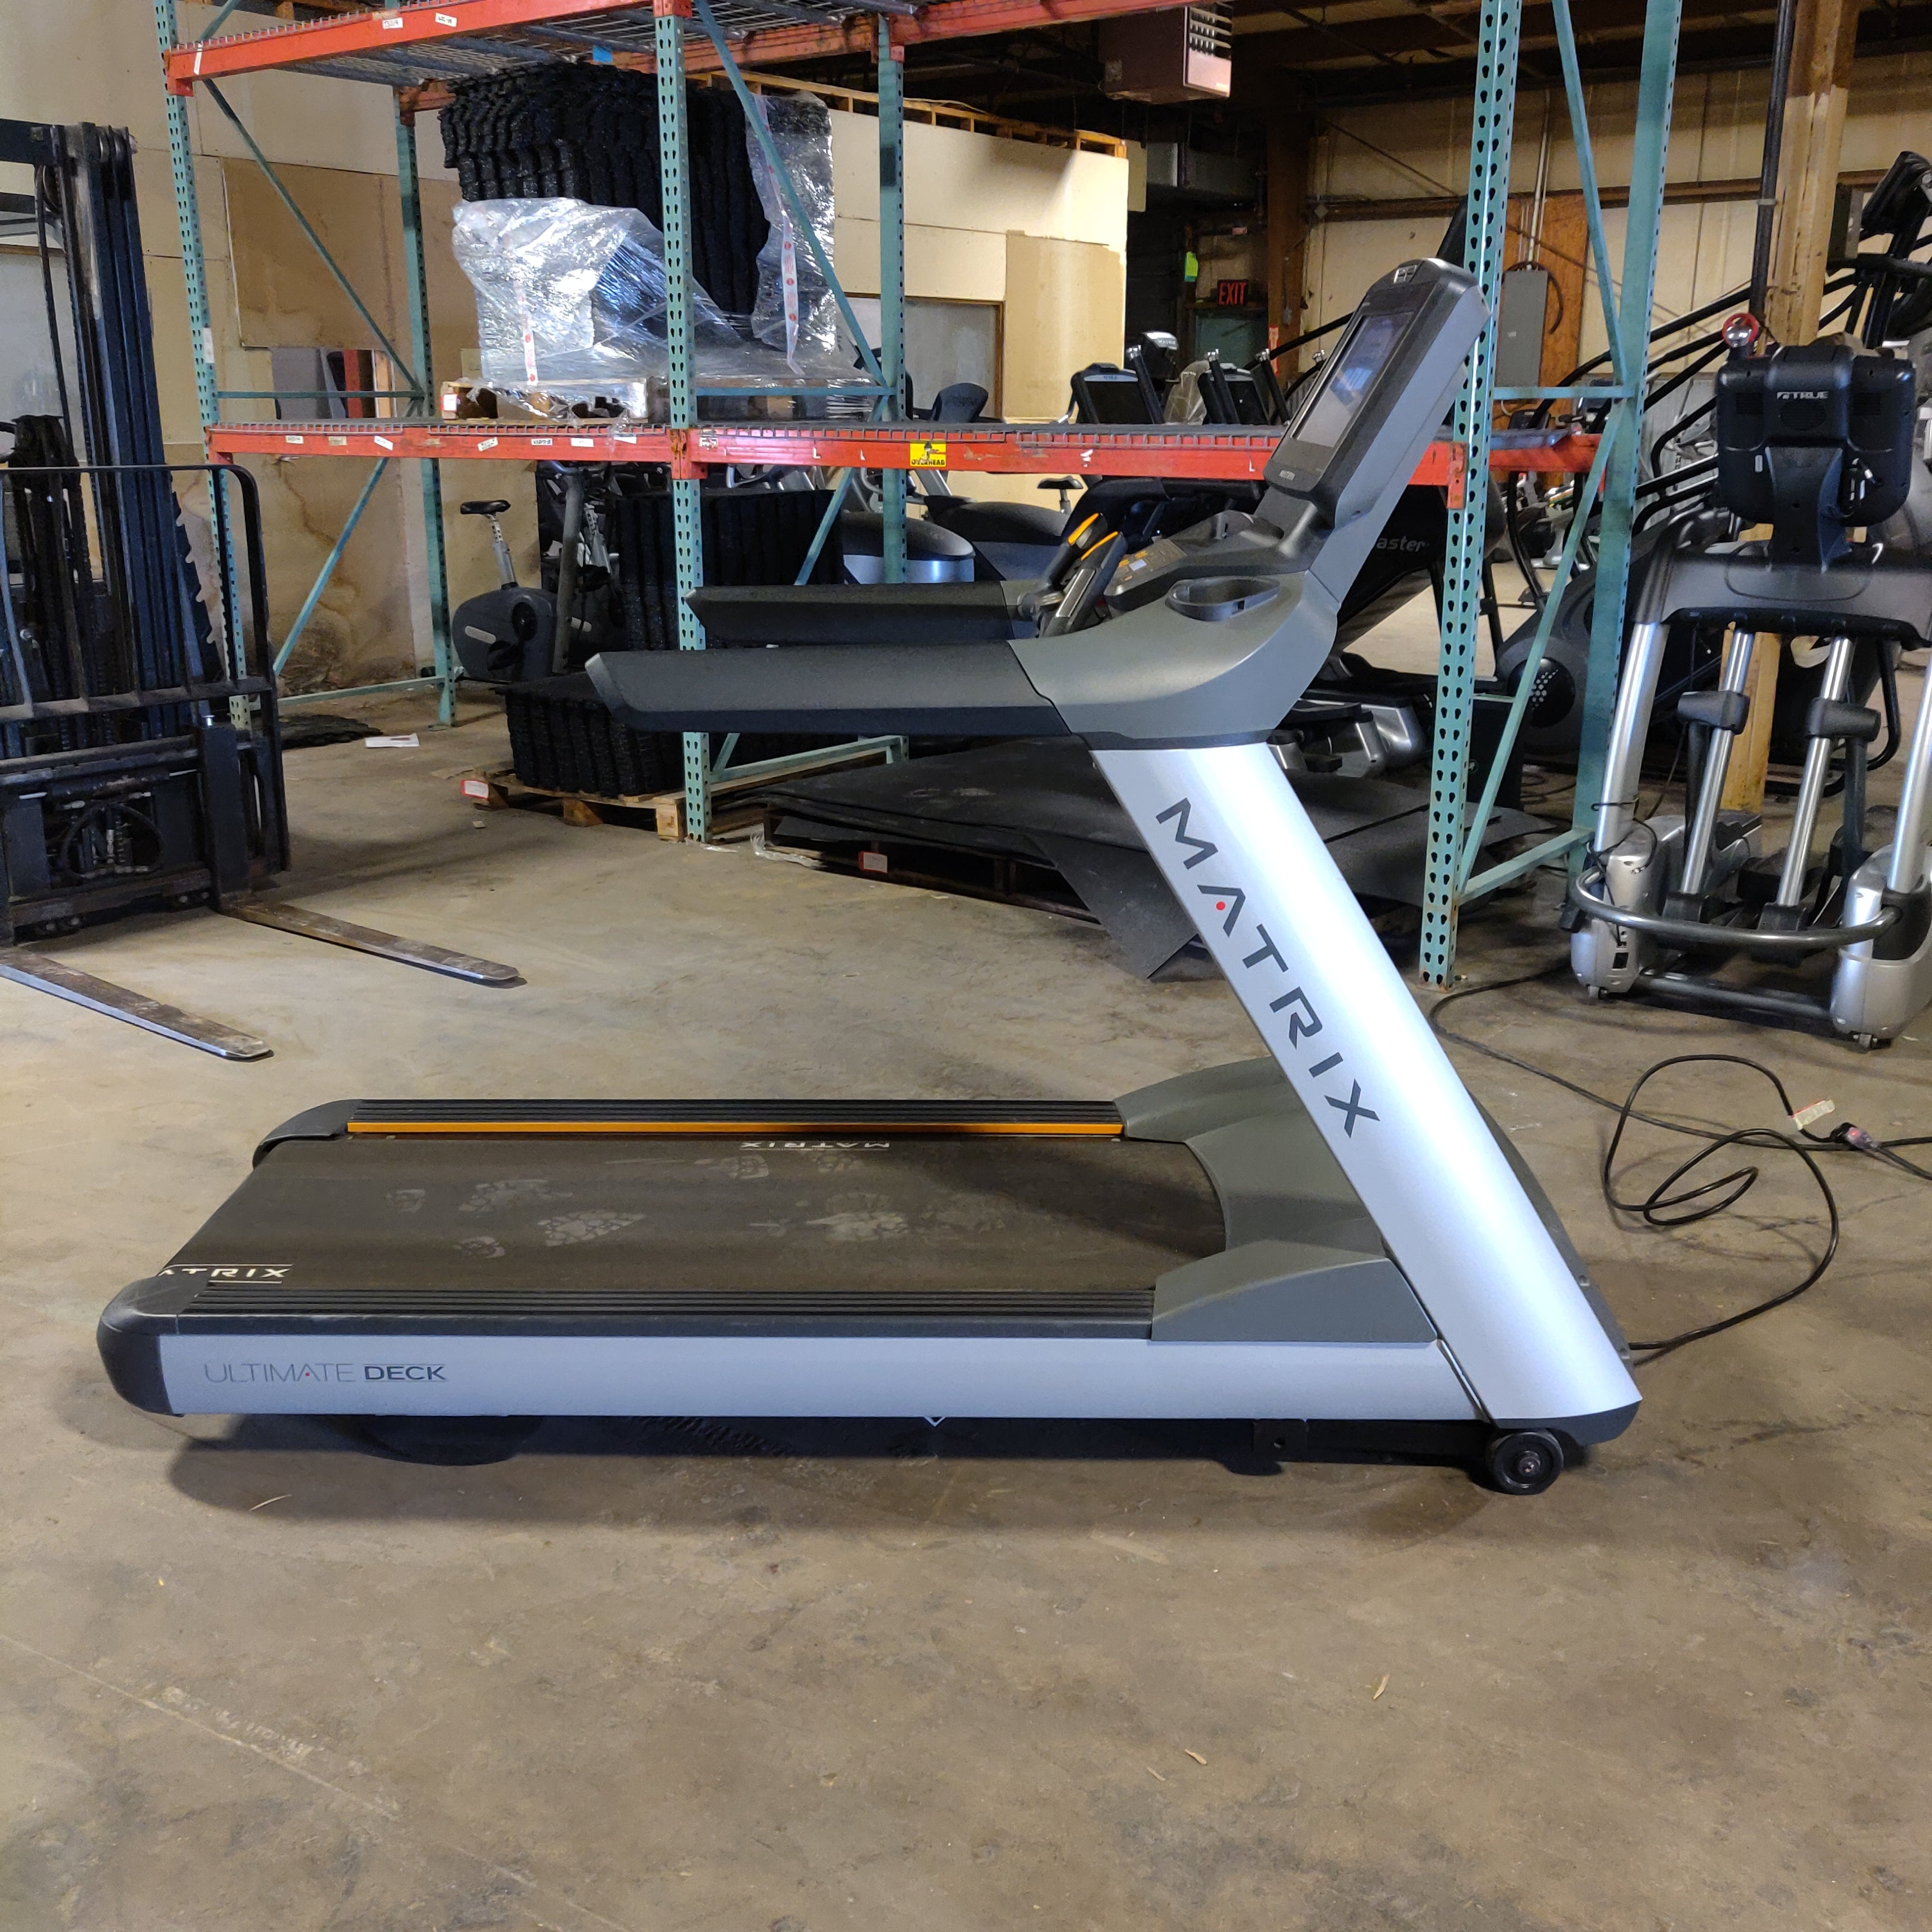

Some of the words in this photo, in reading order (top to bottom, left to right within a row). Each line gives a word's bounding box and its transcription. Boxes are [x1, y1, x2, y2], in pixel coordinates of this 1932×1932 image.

[1219, 282, 1247, 304] EXIT
[1156, 798, 1380, 1138] MATRIX
[204, 1363, 356, 1382] ULTIMATE
[364, 1366, 447, 1380] DECK
